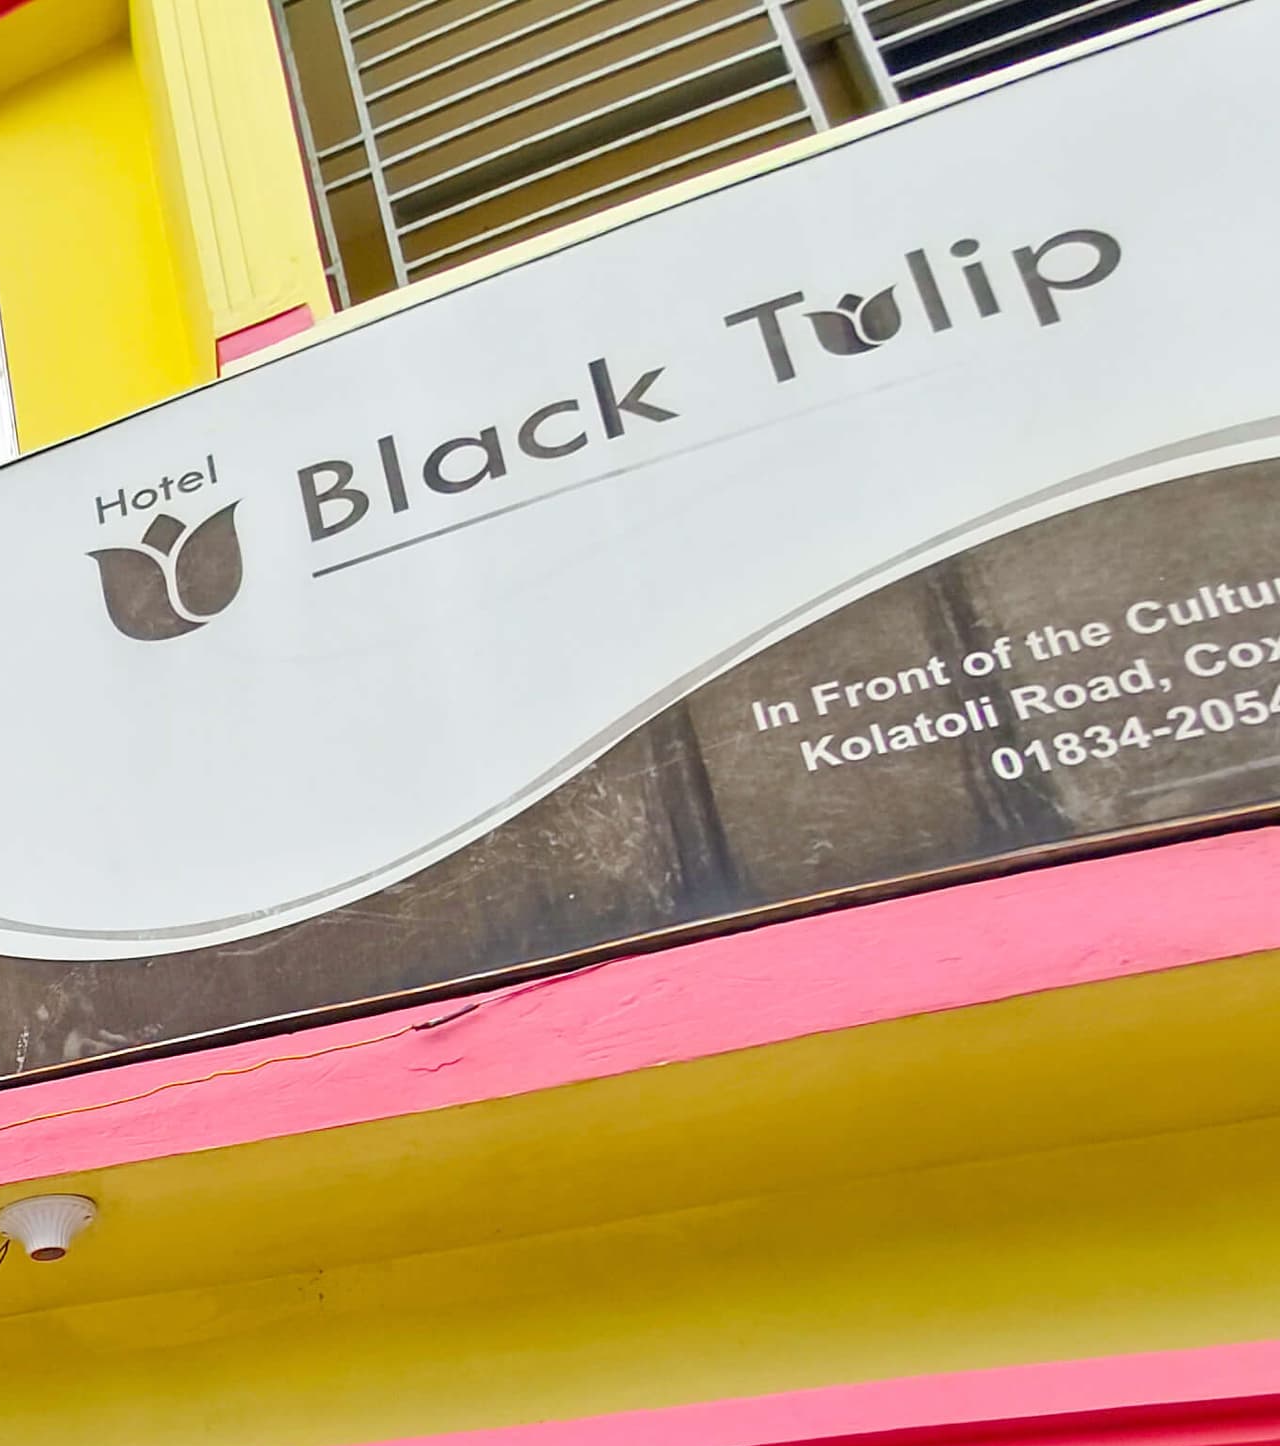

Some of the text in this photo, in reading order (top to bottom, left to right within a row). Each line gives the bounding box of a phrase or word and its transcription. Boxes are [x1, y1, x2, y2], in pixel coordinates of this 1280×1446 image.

[94, 453, 219, 526] Hotel
[295, 357, 680, 542] Black
[751, 700, 799, 731] In
[810, 656, 951, 716] Front
[962, 636, 1013, 678] of
[1025, 621, 1111, 661] the
[800, 696, 1000, 771] Kolatoli
[1010, 659, 1171, 720] Road,
